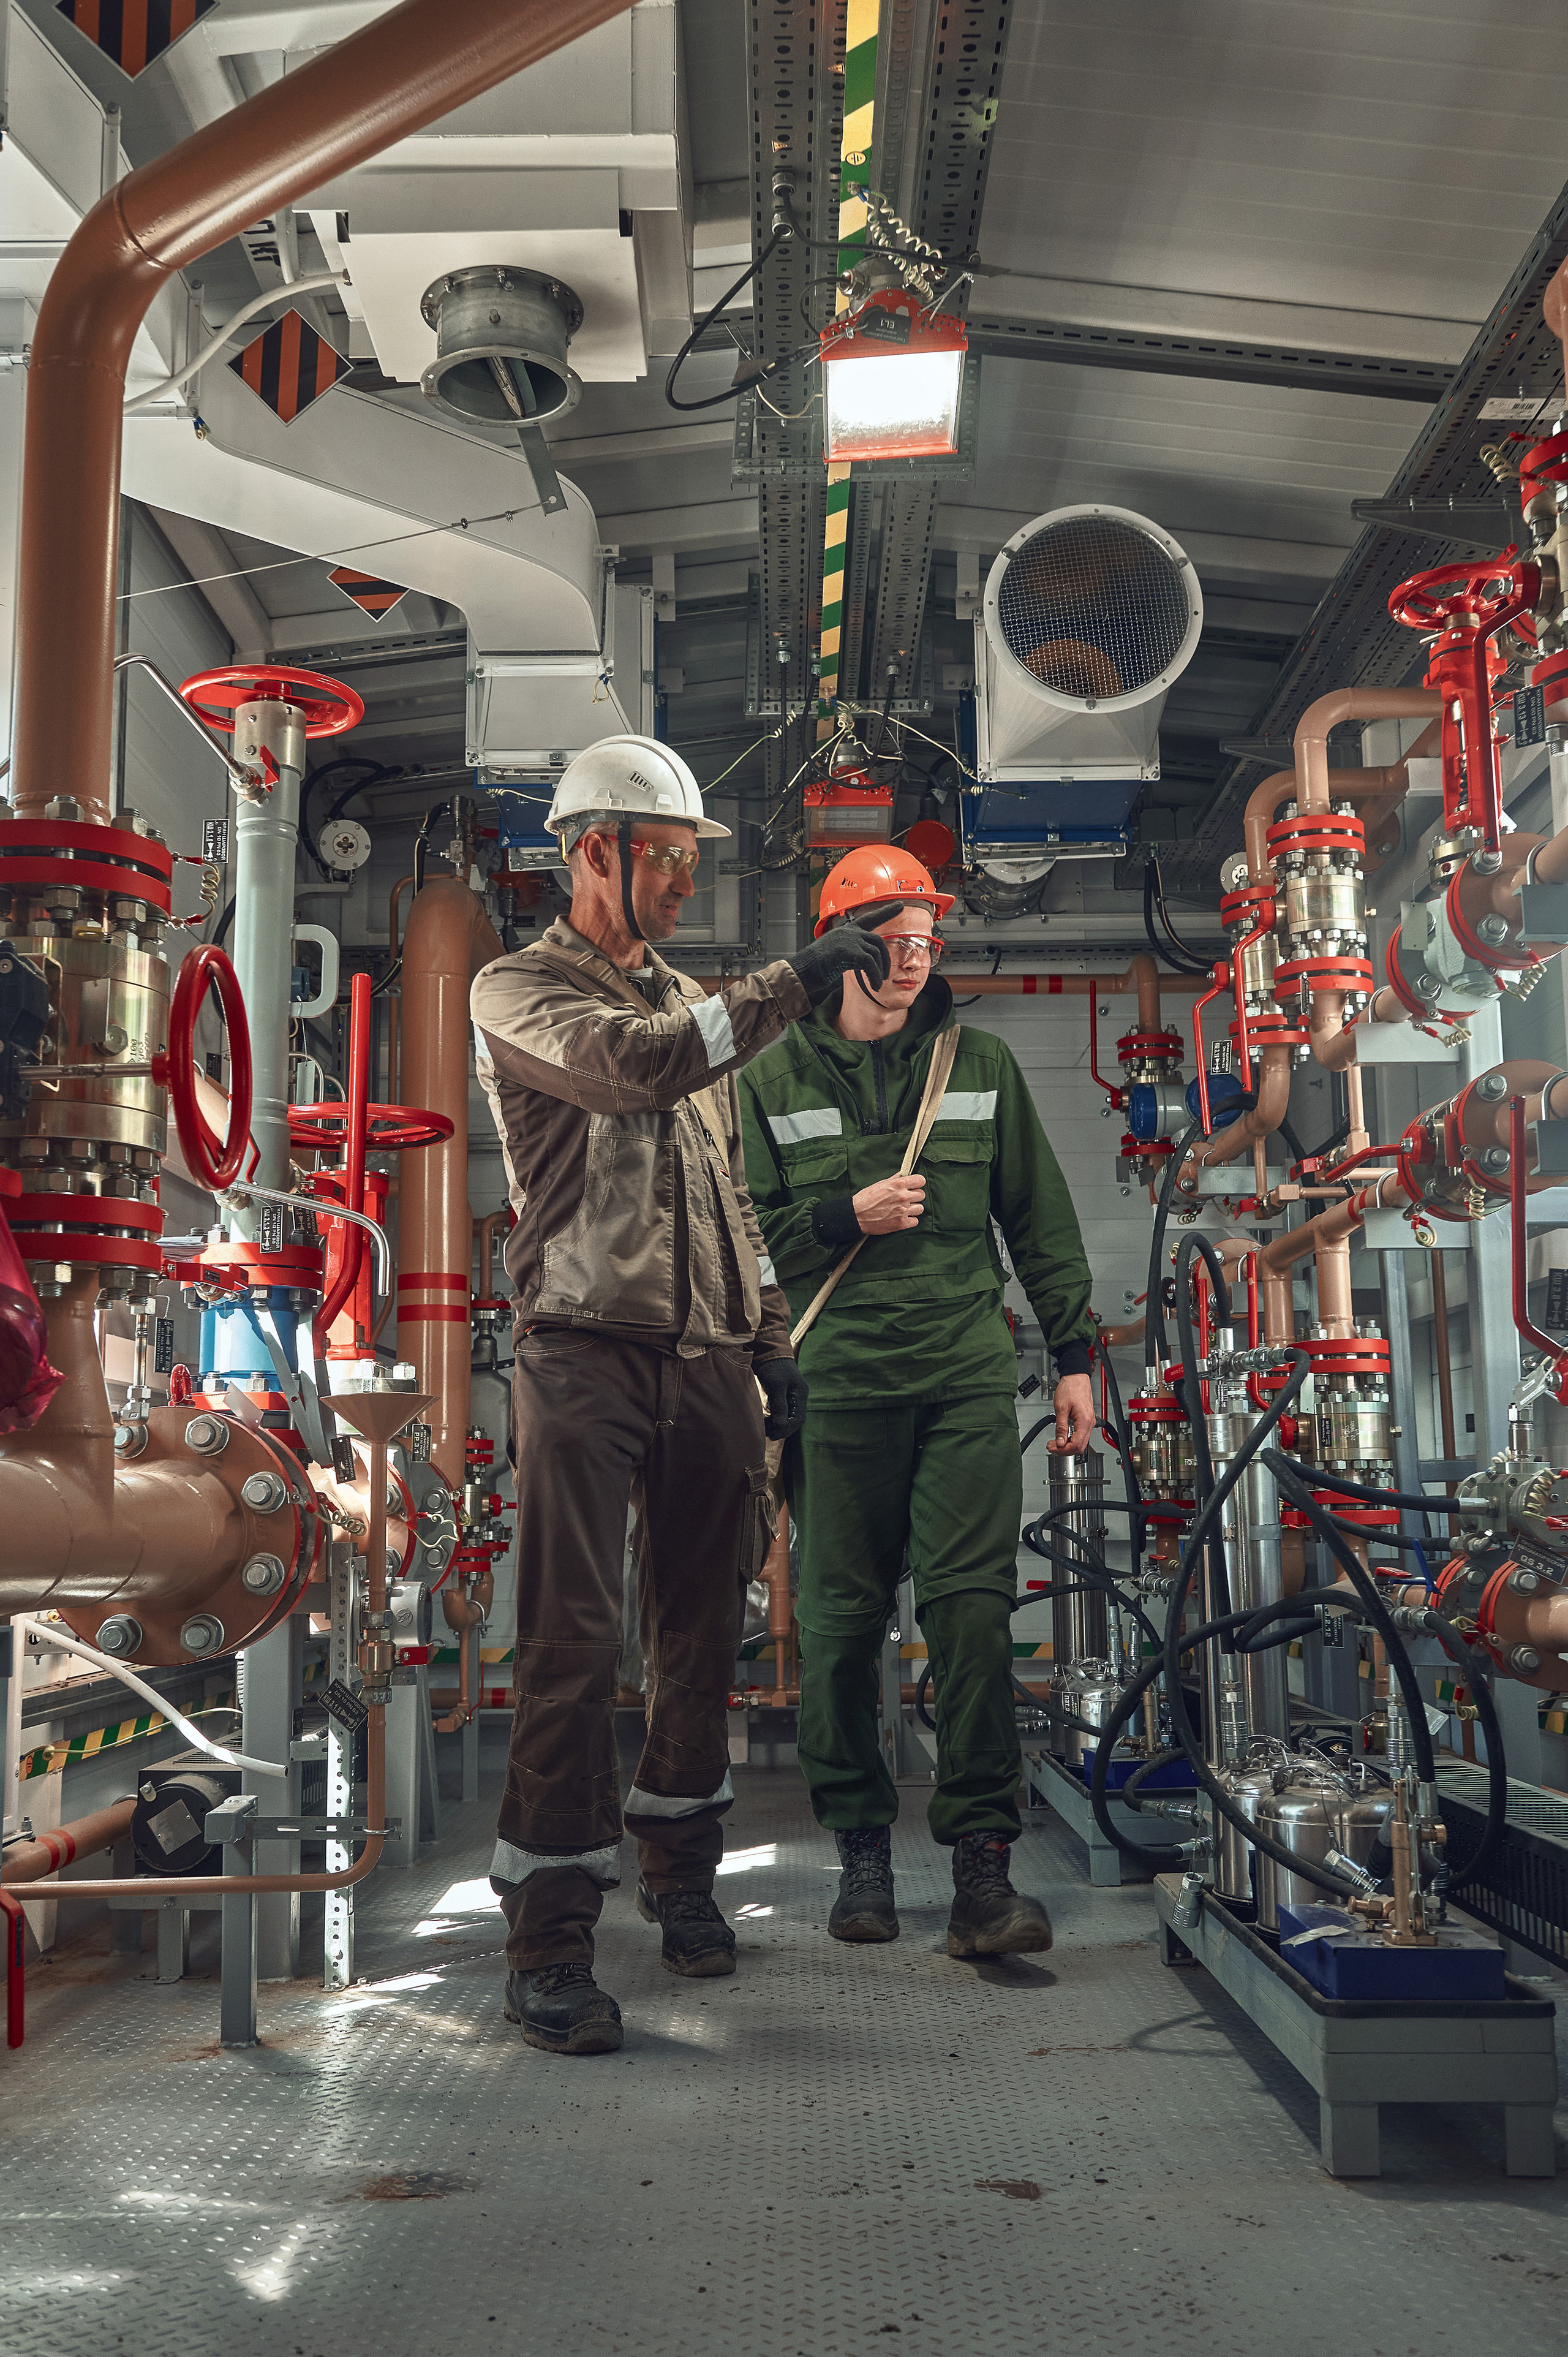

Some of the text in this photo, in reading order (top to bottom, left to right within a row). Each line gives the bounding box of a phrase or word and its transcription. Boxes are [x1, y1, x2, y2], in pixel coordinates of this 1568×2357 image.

[881, 320, 894, 328] EL1
[1517, 692, 1526, 704] КШ
[1554, 1272, 1562, 1285] КШ
[165, 1361, 170, 1371] КШ
[1520, 1554, 1553, 1575] QS 3.2
[322, 1693, 342, 1713] КШ 3.1.5
[334, 1682, 366, 1714] КРАН ШАРОВОЙ
